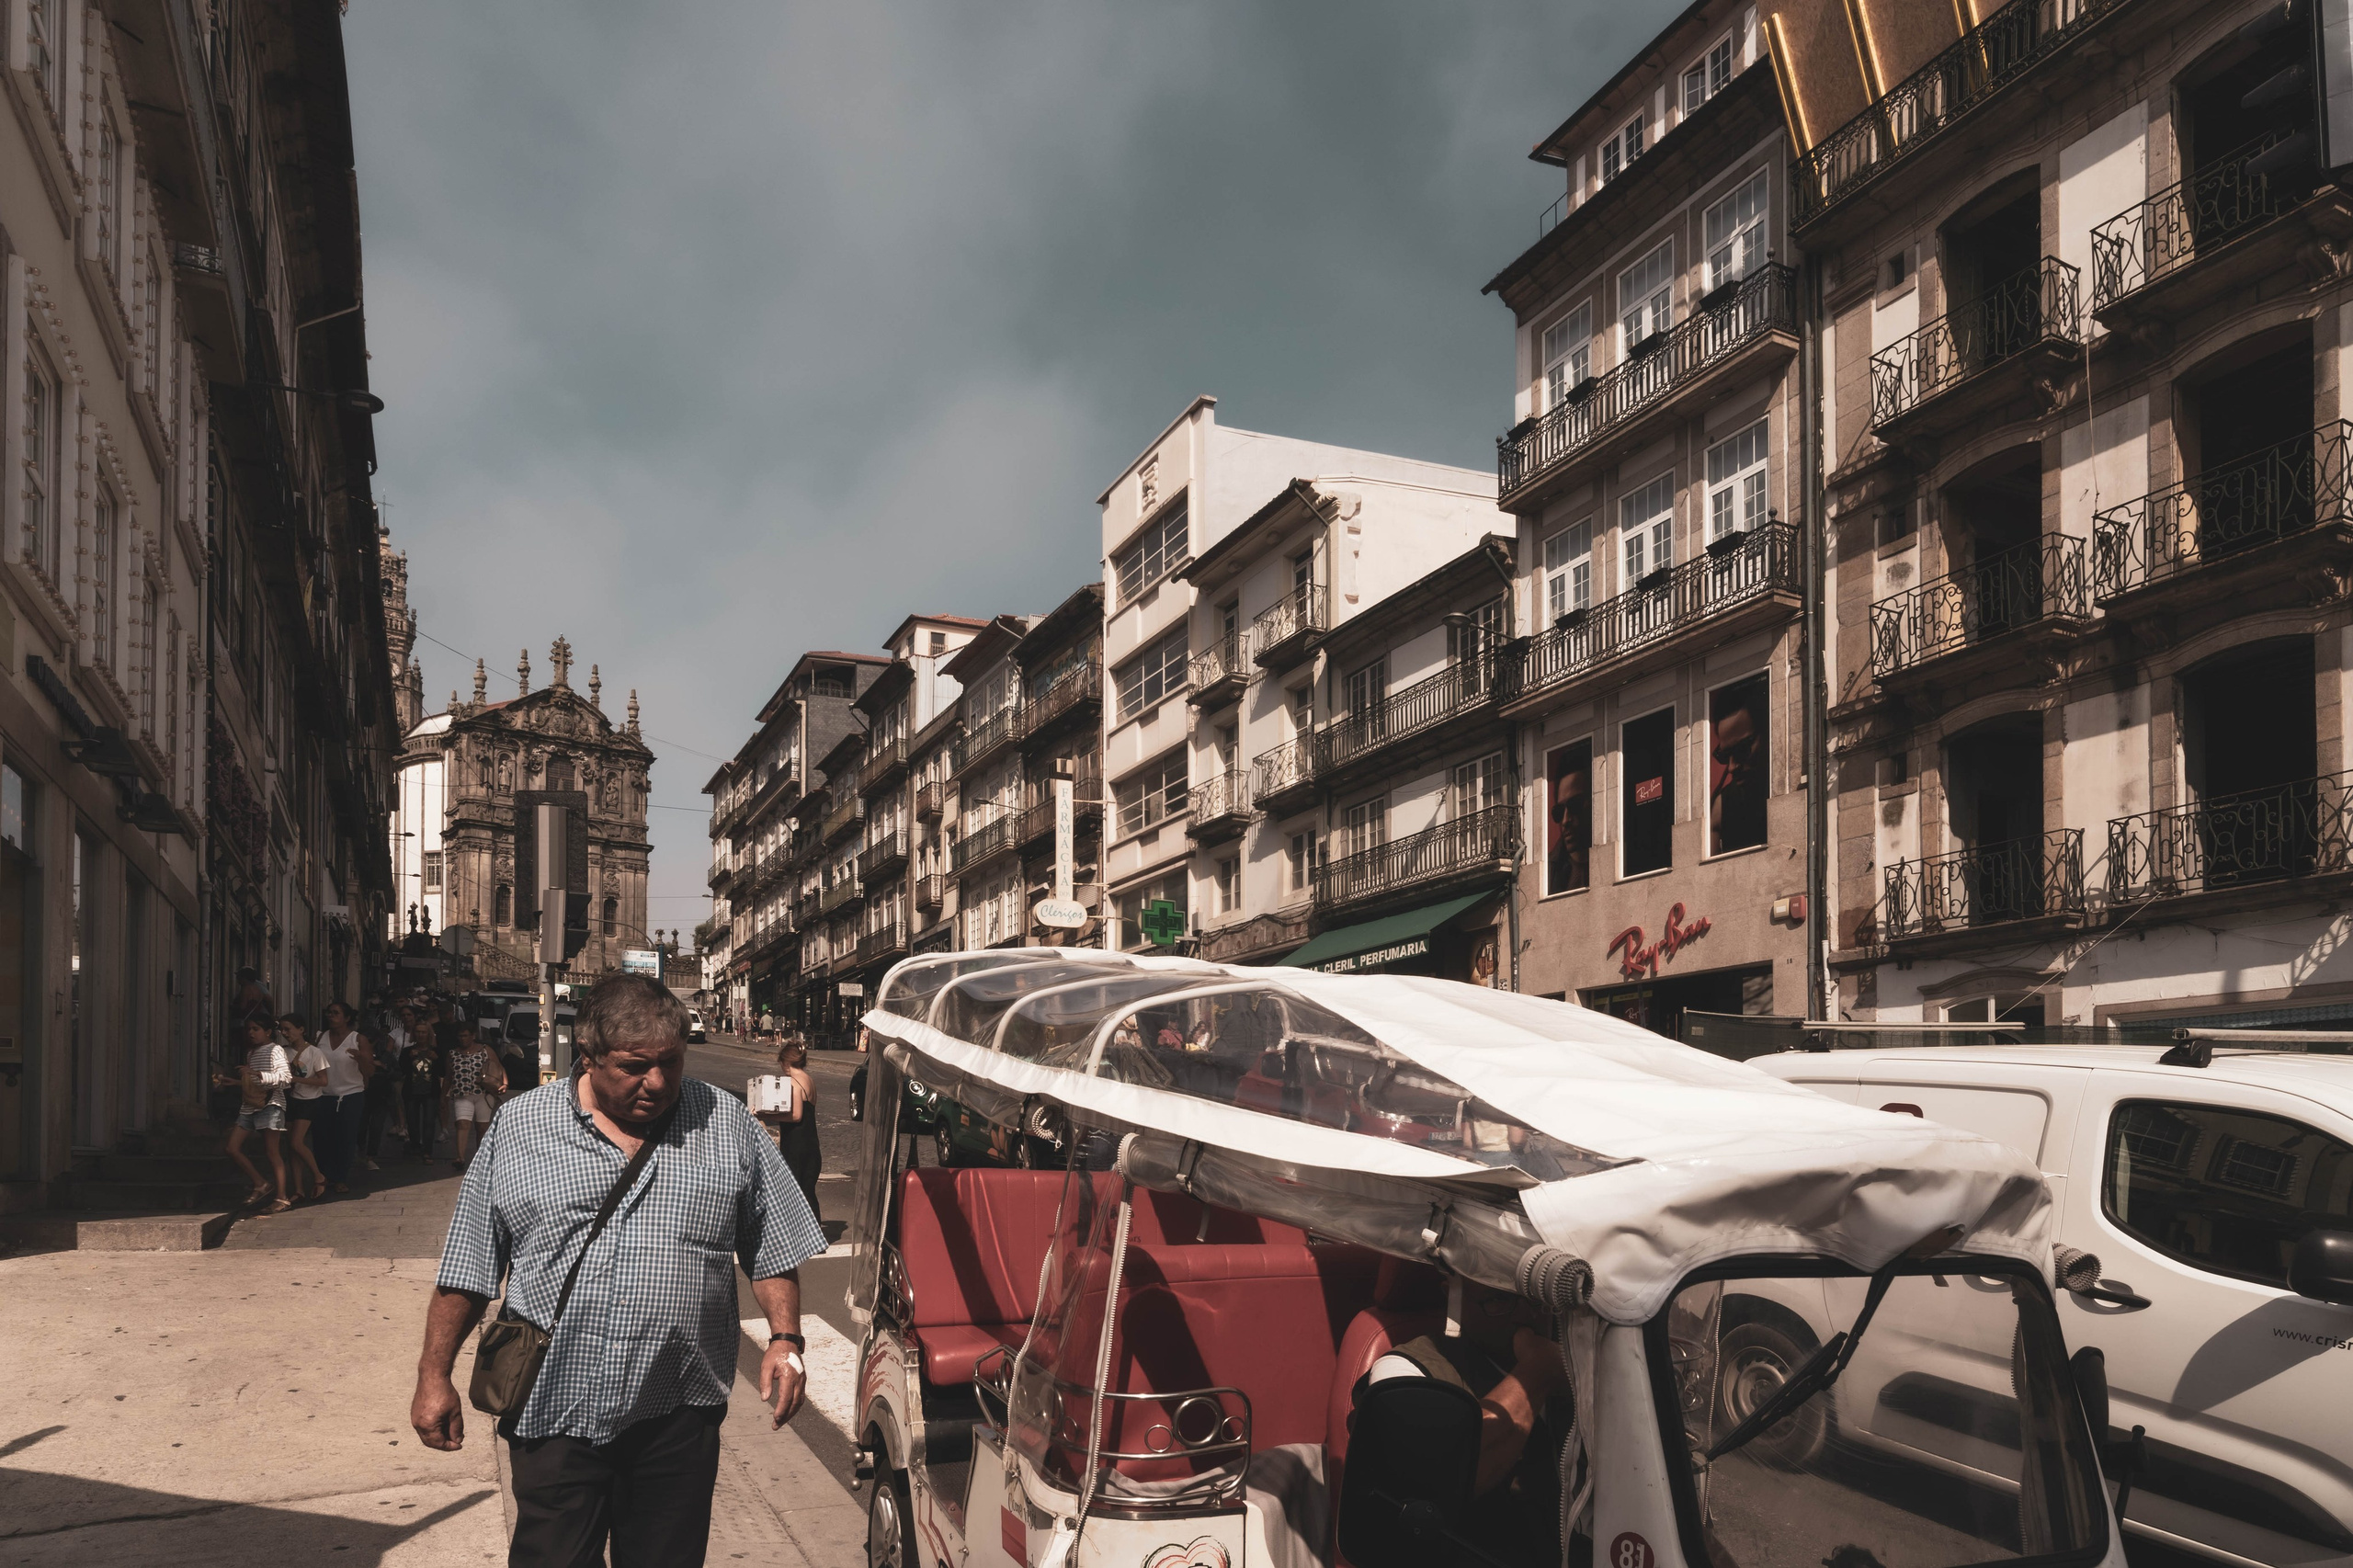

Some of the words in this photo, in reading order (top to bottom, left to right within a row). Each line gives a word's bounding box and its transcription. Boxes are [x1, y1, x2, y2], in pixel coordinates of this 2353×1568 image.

[1636, 779, 1661, 800] Ray-Ban
[1059, 788, 1071, 887] FARMÁCIA
[1040, 904, 1084, 923] Clérigos
[1608, 902, 1711, 975] Ray-Ban
[1324, 958, 1356, 973] CLERIL
[1360, 940, 1427, 966] PERFUMARIA
[1620, 1540, 1644, 1568] 81
